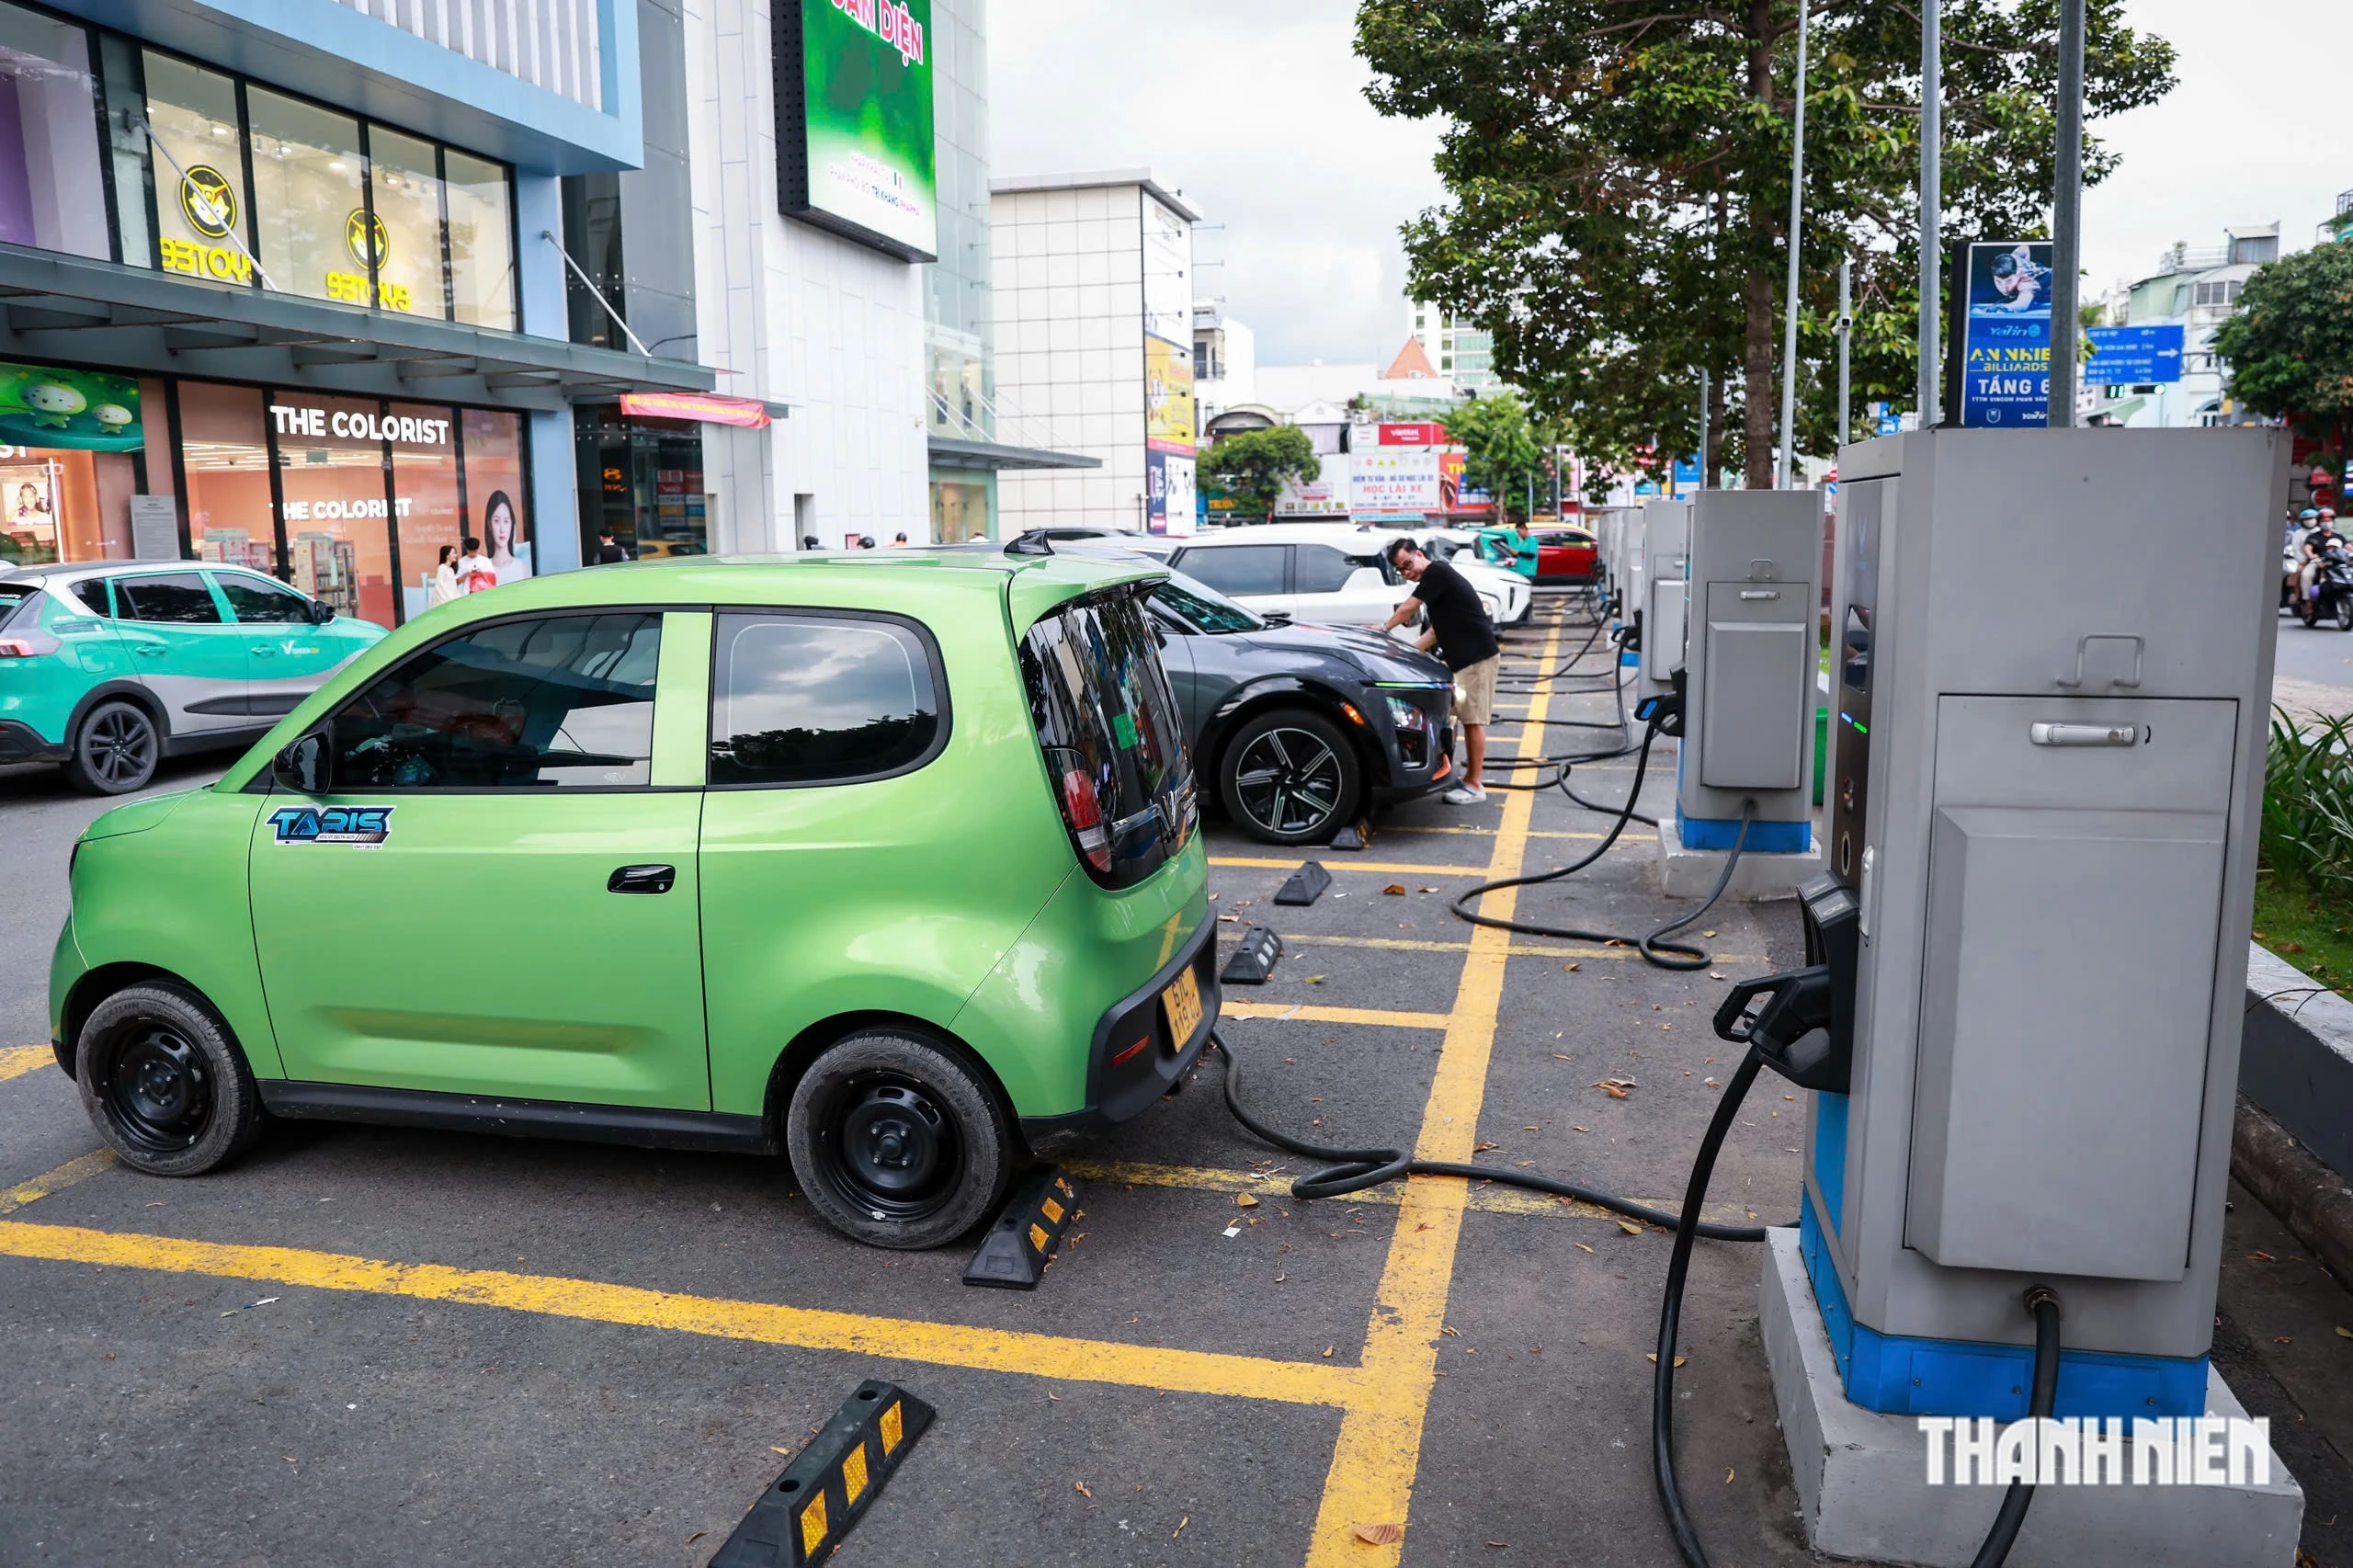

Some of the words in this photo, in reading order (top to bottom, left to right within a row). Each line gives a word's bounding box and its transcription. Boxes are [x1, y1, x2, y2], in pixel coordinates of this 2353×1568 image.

[879, 0, 924, 67] DIỆN
[159, 237, 253, 282] 93TOY
[2006, 347, 2051, 361] NHIE
[1984, 362, 2048, 372] BILLIARDS
[269, 405, 326, 437] THE
[331, 411, 449, 445] COLORIST
[269, 501, 309, 520] HE
[274, 811, 386, 836] TARIS
